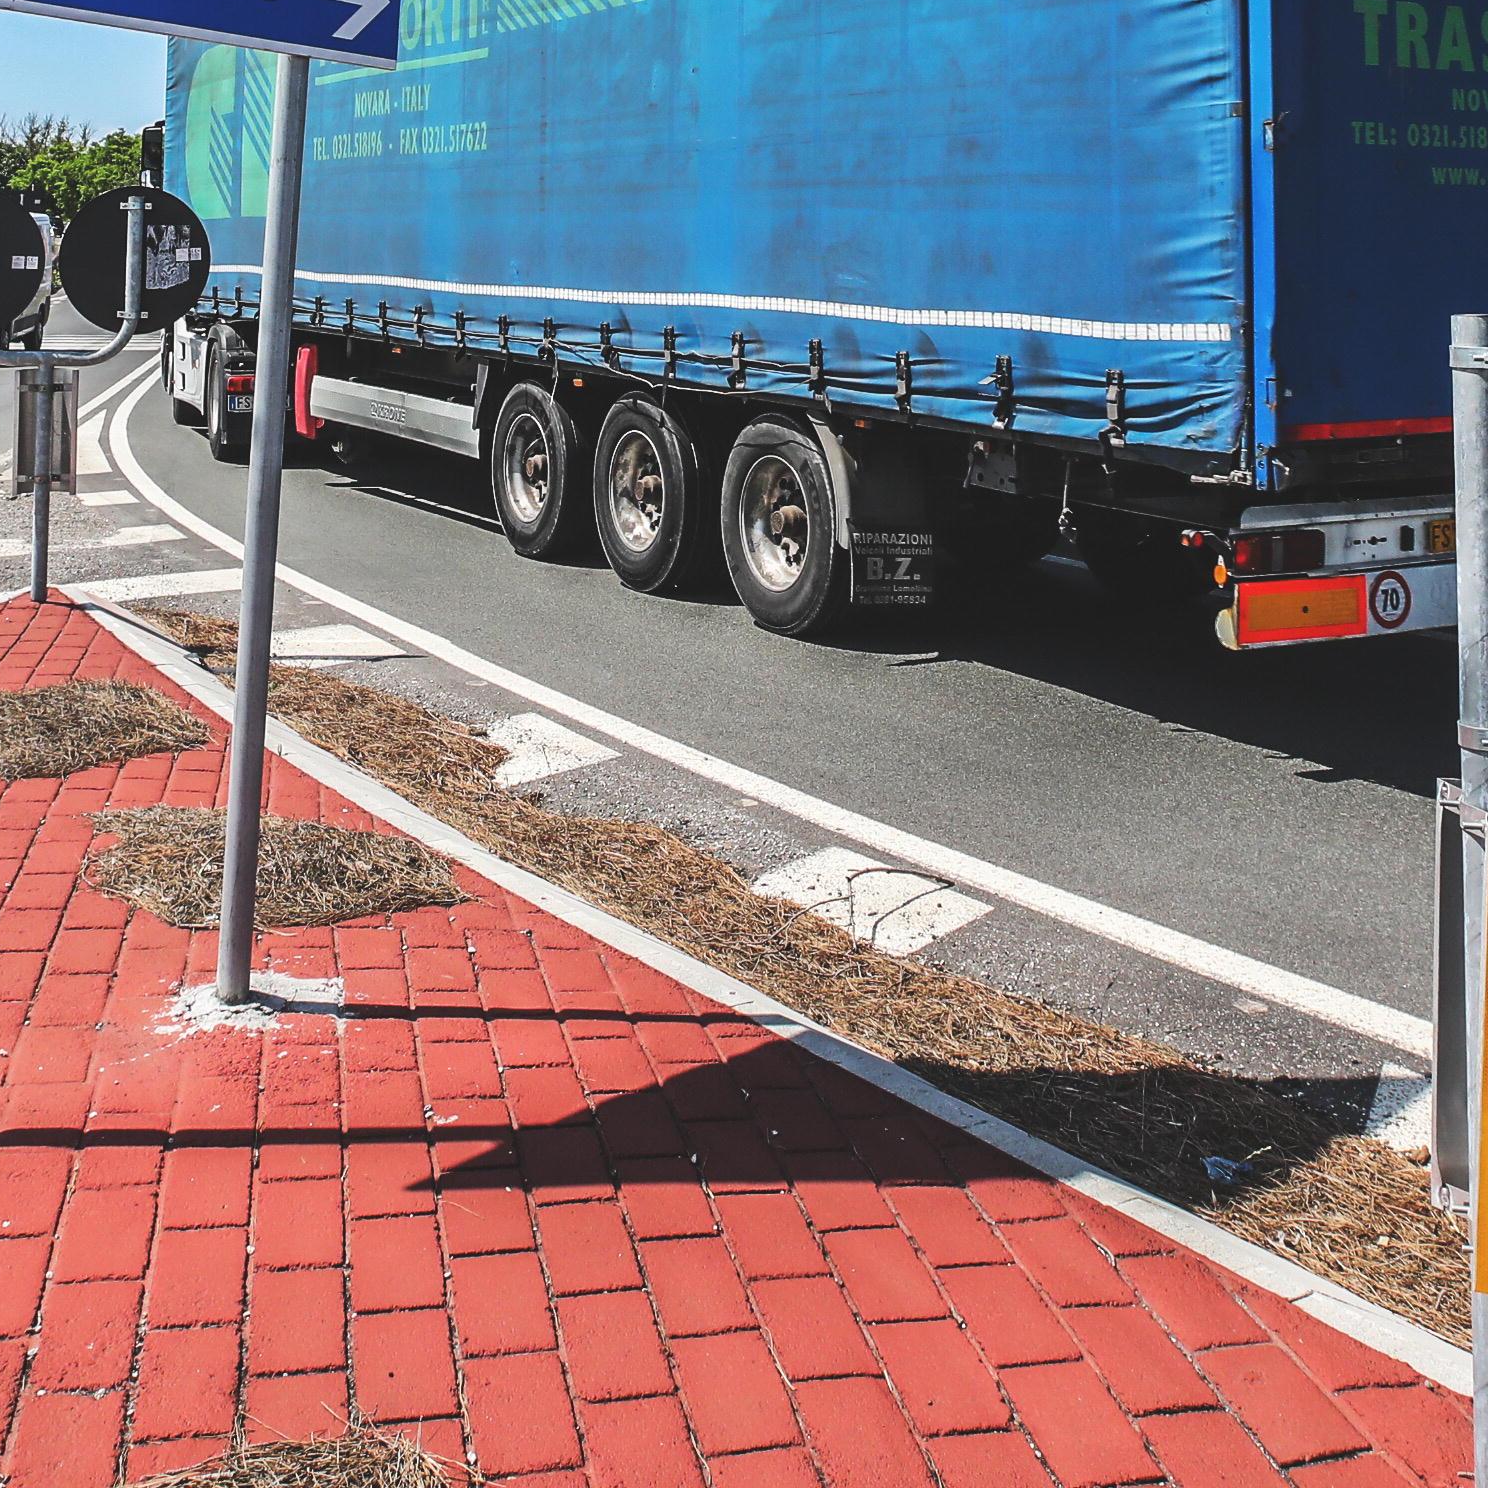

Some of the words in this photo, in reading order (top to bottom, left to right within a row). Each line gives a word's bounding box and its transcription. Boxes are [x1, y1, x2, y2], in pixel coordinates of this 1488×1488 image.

[354, 89, 391, 119] NOVARA
[401, 83, 431, 113] ITALY
[313, 135, 330, 161] TEL.
[332, 130, 383, 160] 0321.518196
[399, 127, 418, 155] FAX
[421, 120, 488, 154] 0321.517622
[1351, 120, 1398, 146] TEL:
[852, 533, 933, 545] RIPARAZIONI
[886, 546, 933, 556] Industriali
[866, 557, 921, 580] B.Z.
[1380, 587, 1401, 613] 70
